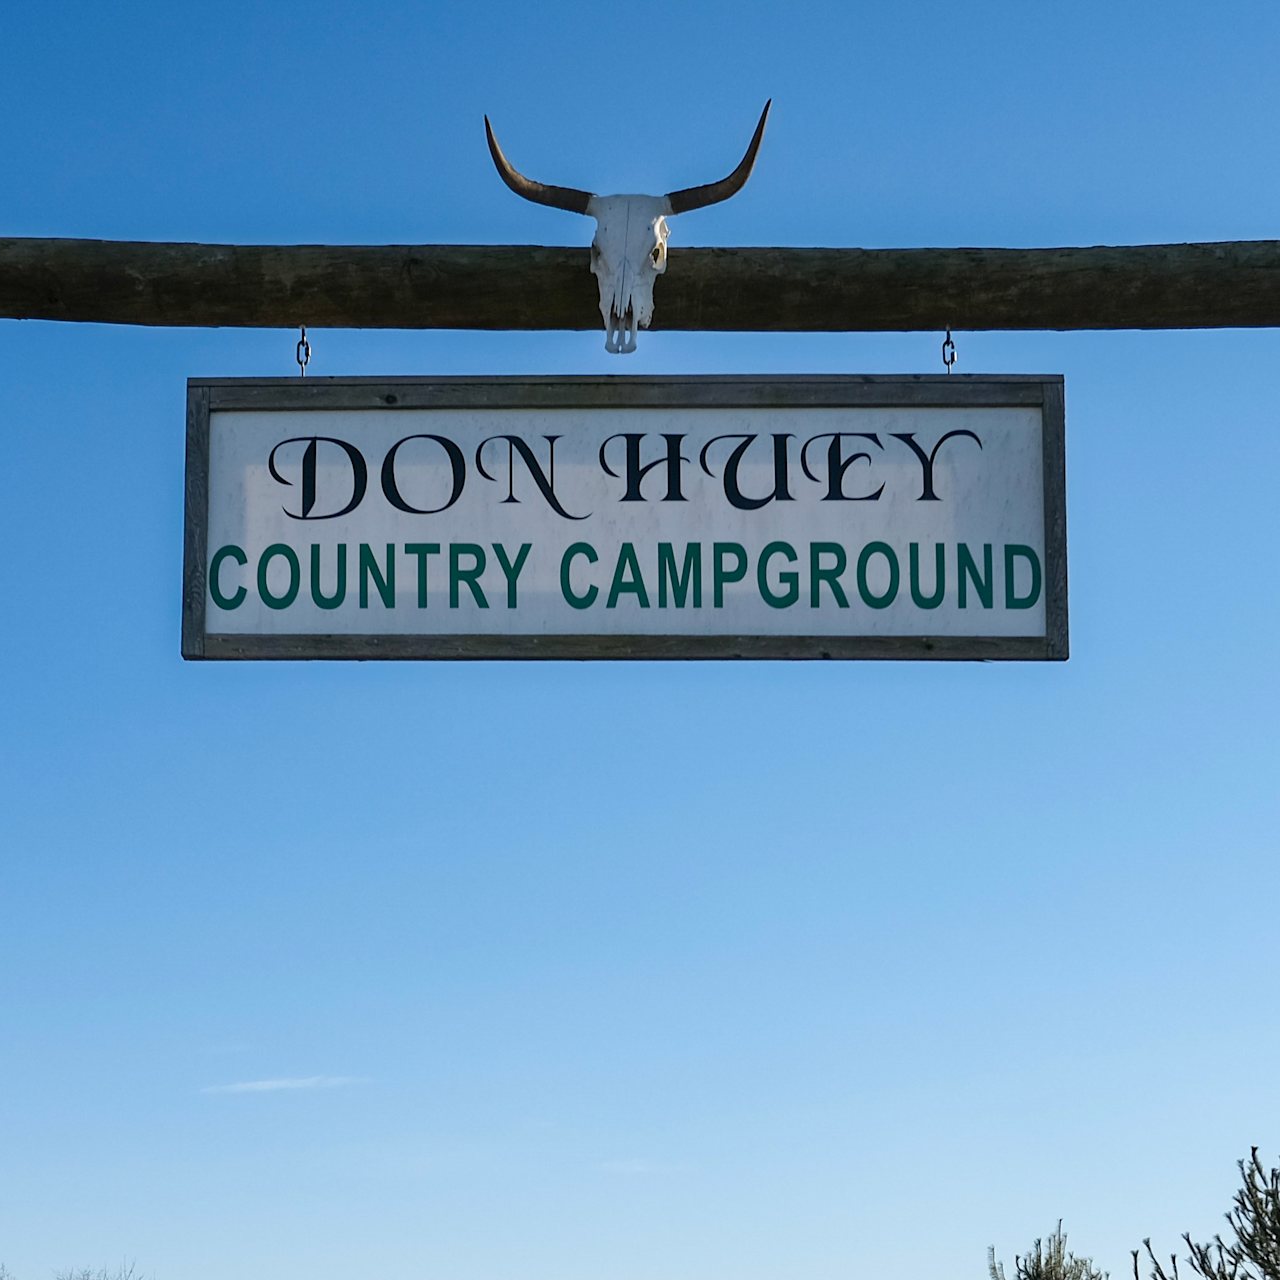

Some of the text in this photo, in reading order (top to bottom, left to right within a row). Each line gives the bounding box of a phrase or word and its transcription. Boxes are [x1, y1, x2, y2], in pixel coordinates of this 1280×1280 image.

[268, 428, 983, 521] DON HUEY
[209, 541, 1042, 611] COUNTRY CAMPGROUND
